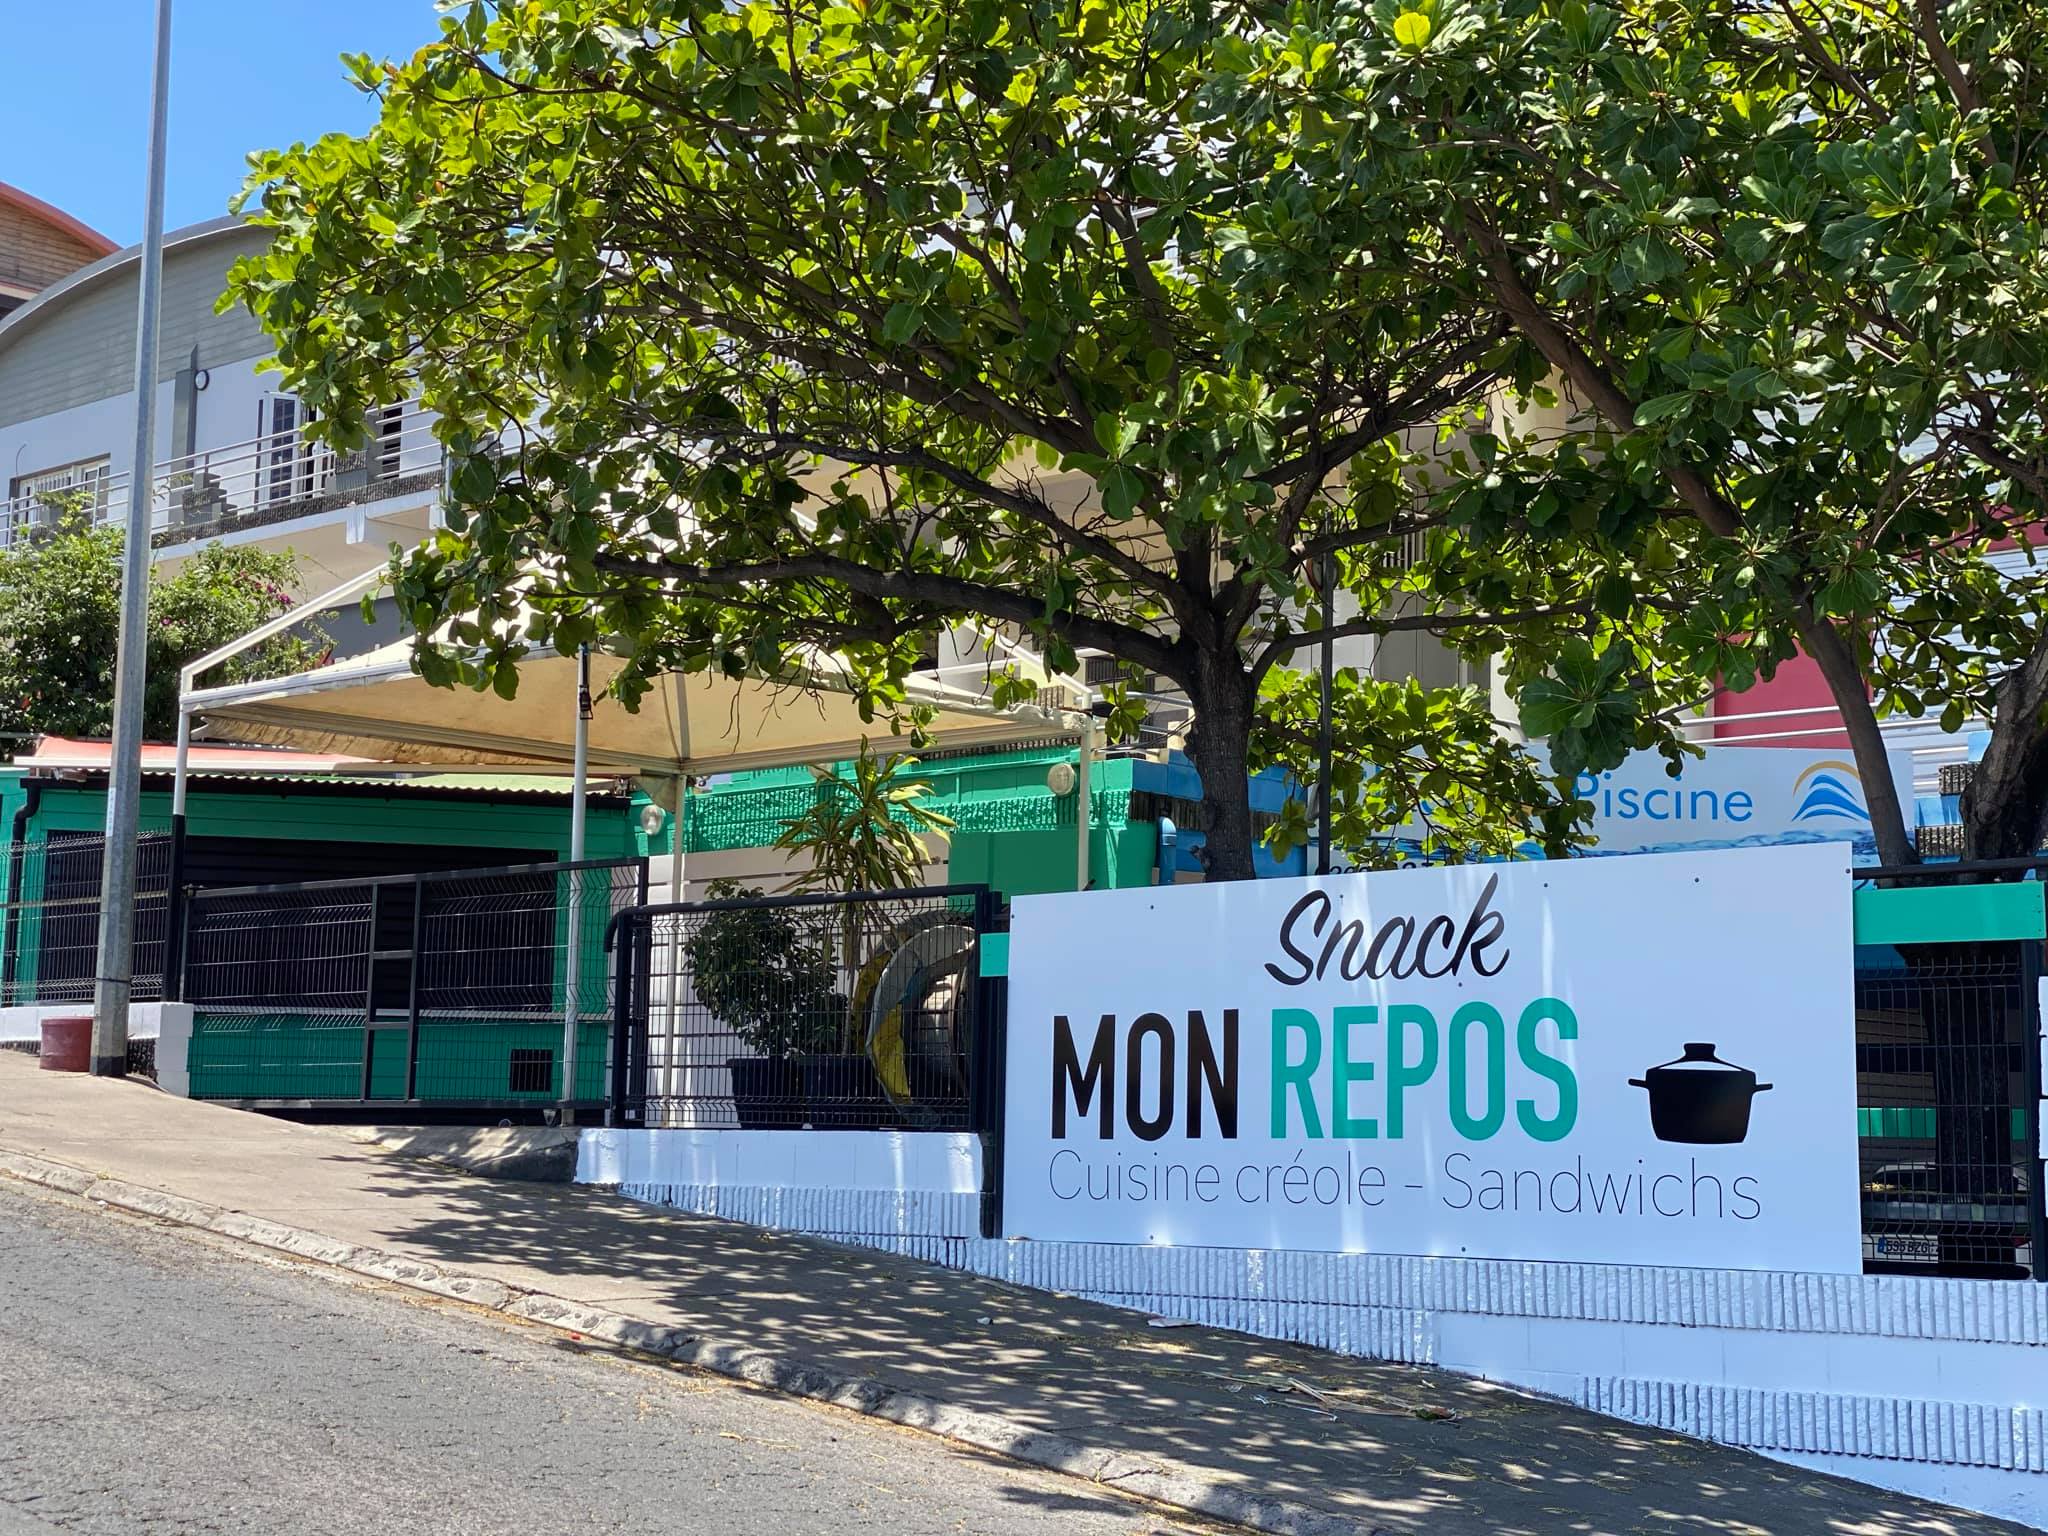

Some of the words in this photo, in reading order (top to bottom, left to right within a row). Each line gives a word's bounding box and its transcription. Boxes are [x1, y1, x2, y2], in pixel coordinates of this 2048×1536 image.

[1573, 771, 1753, 822] Piscine
[1264, 873, 1510, 986] Snack
[1052, 1008, 1240, 1143] MON
[1271, 997, 1579, 1143] REPOS
[1049, 1149, 1221, 1203] Cuisine
[1235, 1148, 1386, 1207] créole
[1442, 1152, 1761, 1220] Sandwichs
